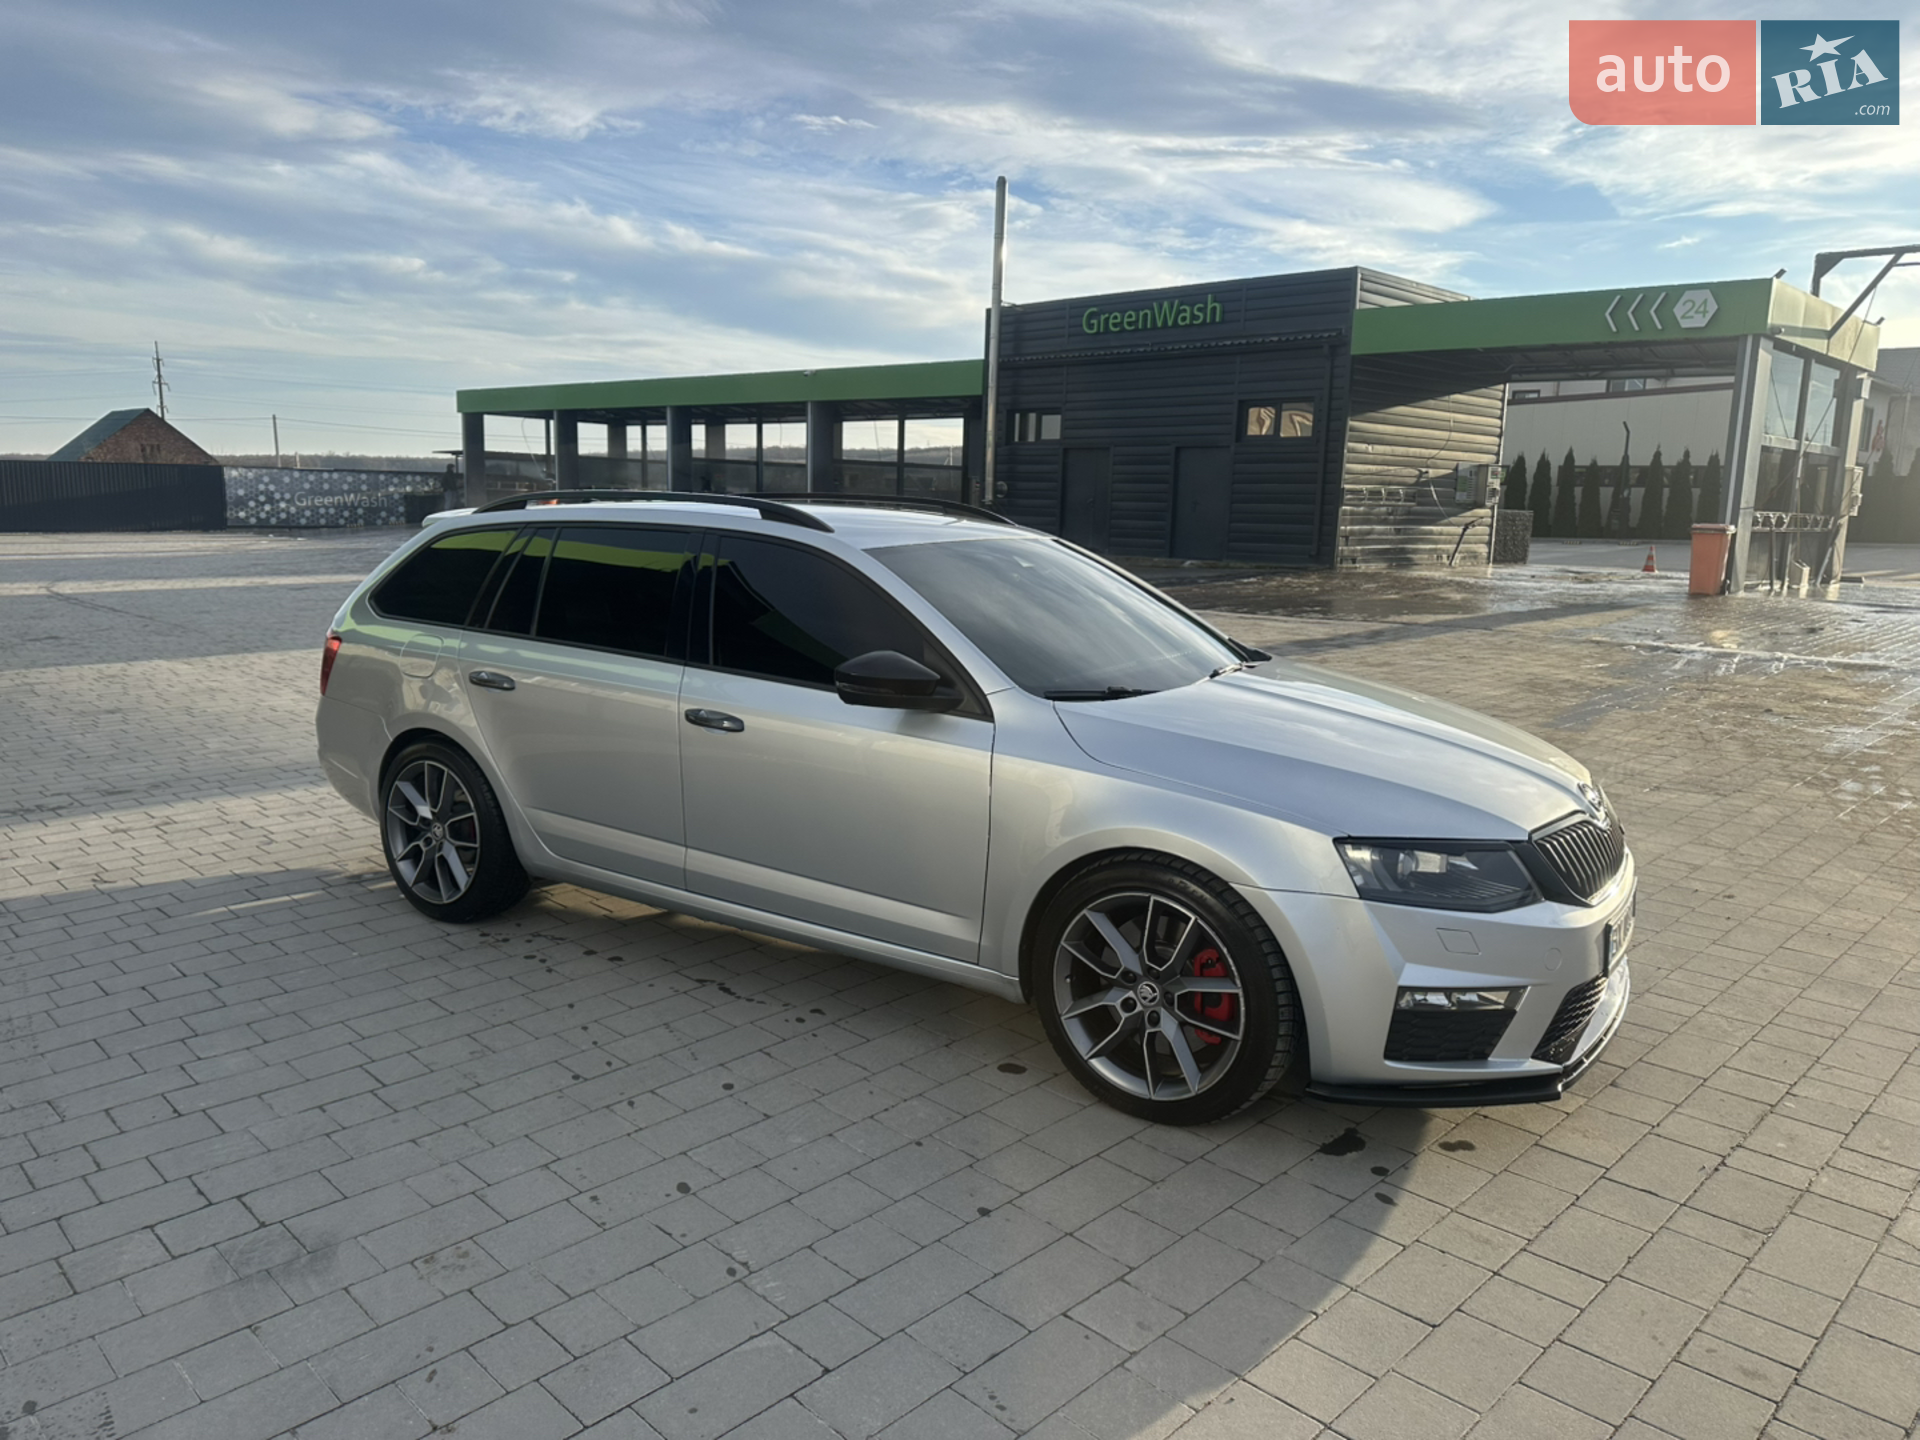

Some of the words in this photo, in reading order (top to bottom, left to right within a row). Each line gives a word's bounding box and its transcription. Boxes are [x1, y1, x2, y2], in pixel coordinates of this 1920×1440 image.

[1081, 294, 1223, 334] GreenWash
[1680, 298, 1709, 320] 24
[294, 491, 388, 508] GreenWash
